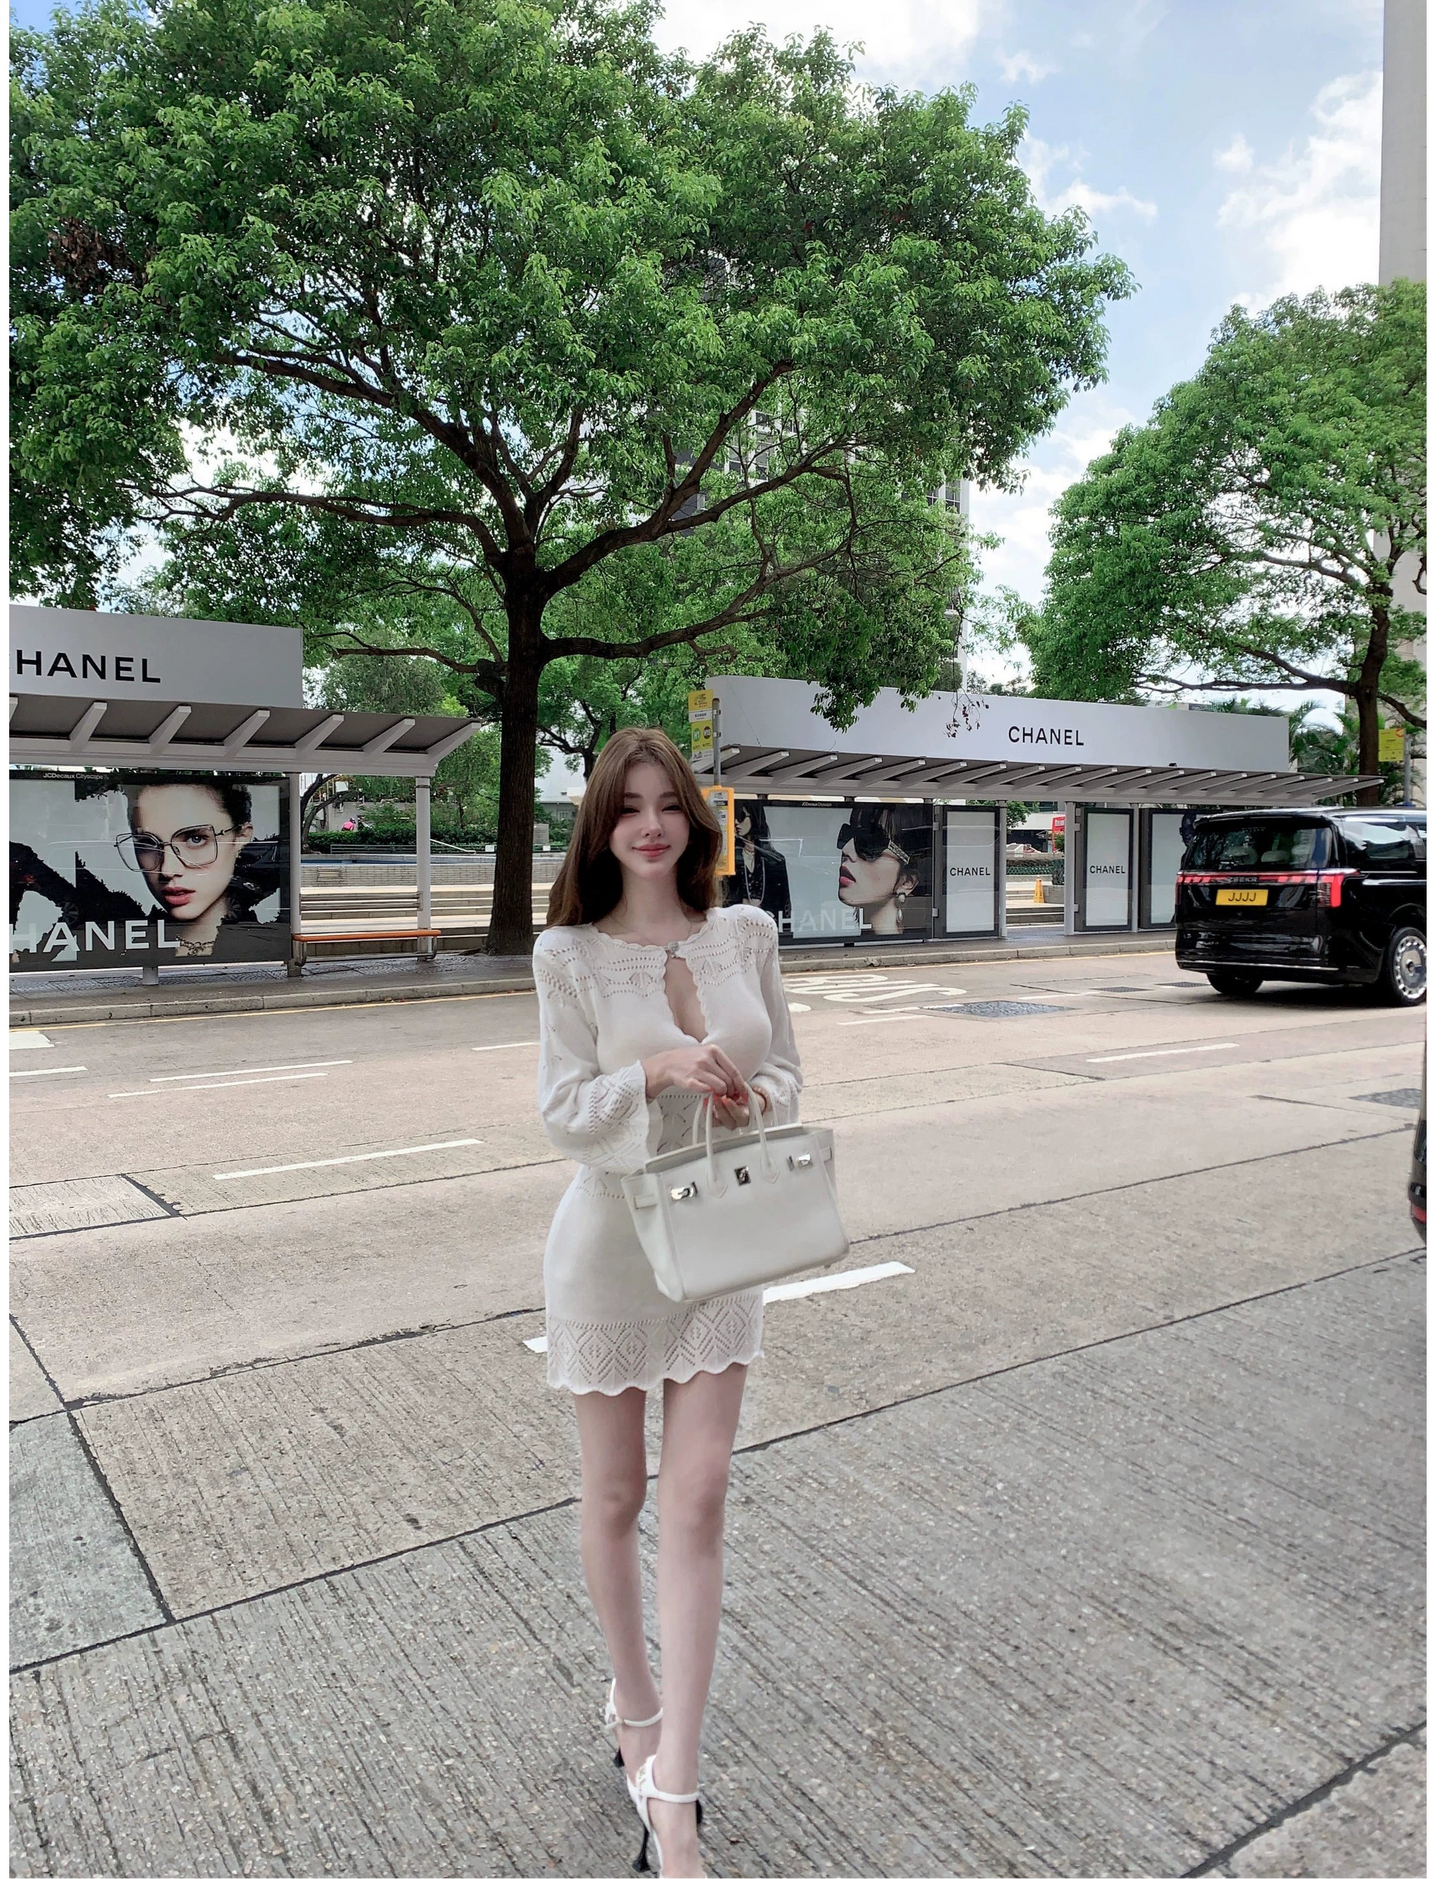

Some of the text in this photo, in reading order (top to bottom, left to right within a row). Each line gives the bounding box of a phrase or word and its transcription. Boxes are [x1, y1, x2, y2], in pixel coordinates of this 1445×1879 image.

[9, 649, 161, 683] HANEL
[1008, 725, 1084, 746] CHANEL
[950, 867, 991, 877] CHANEL
[1089, 865, 1126, 874] CHANEL
[1228, 892, 1257, 902] JJJJ
[766, 907, 873, 933] HANEL
[9, 919, 181, 954] HANEL
